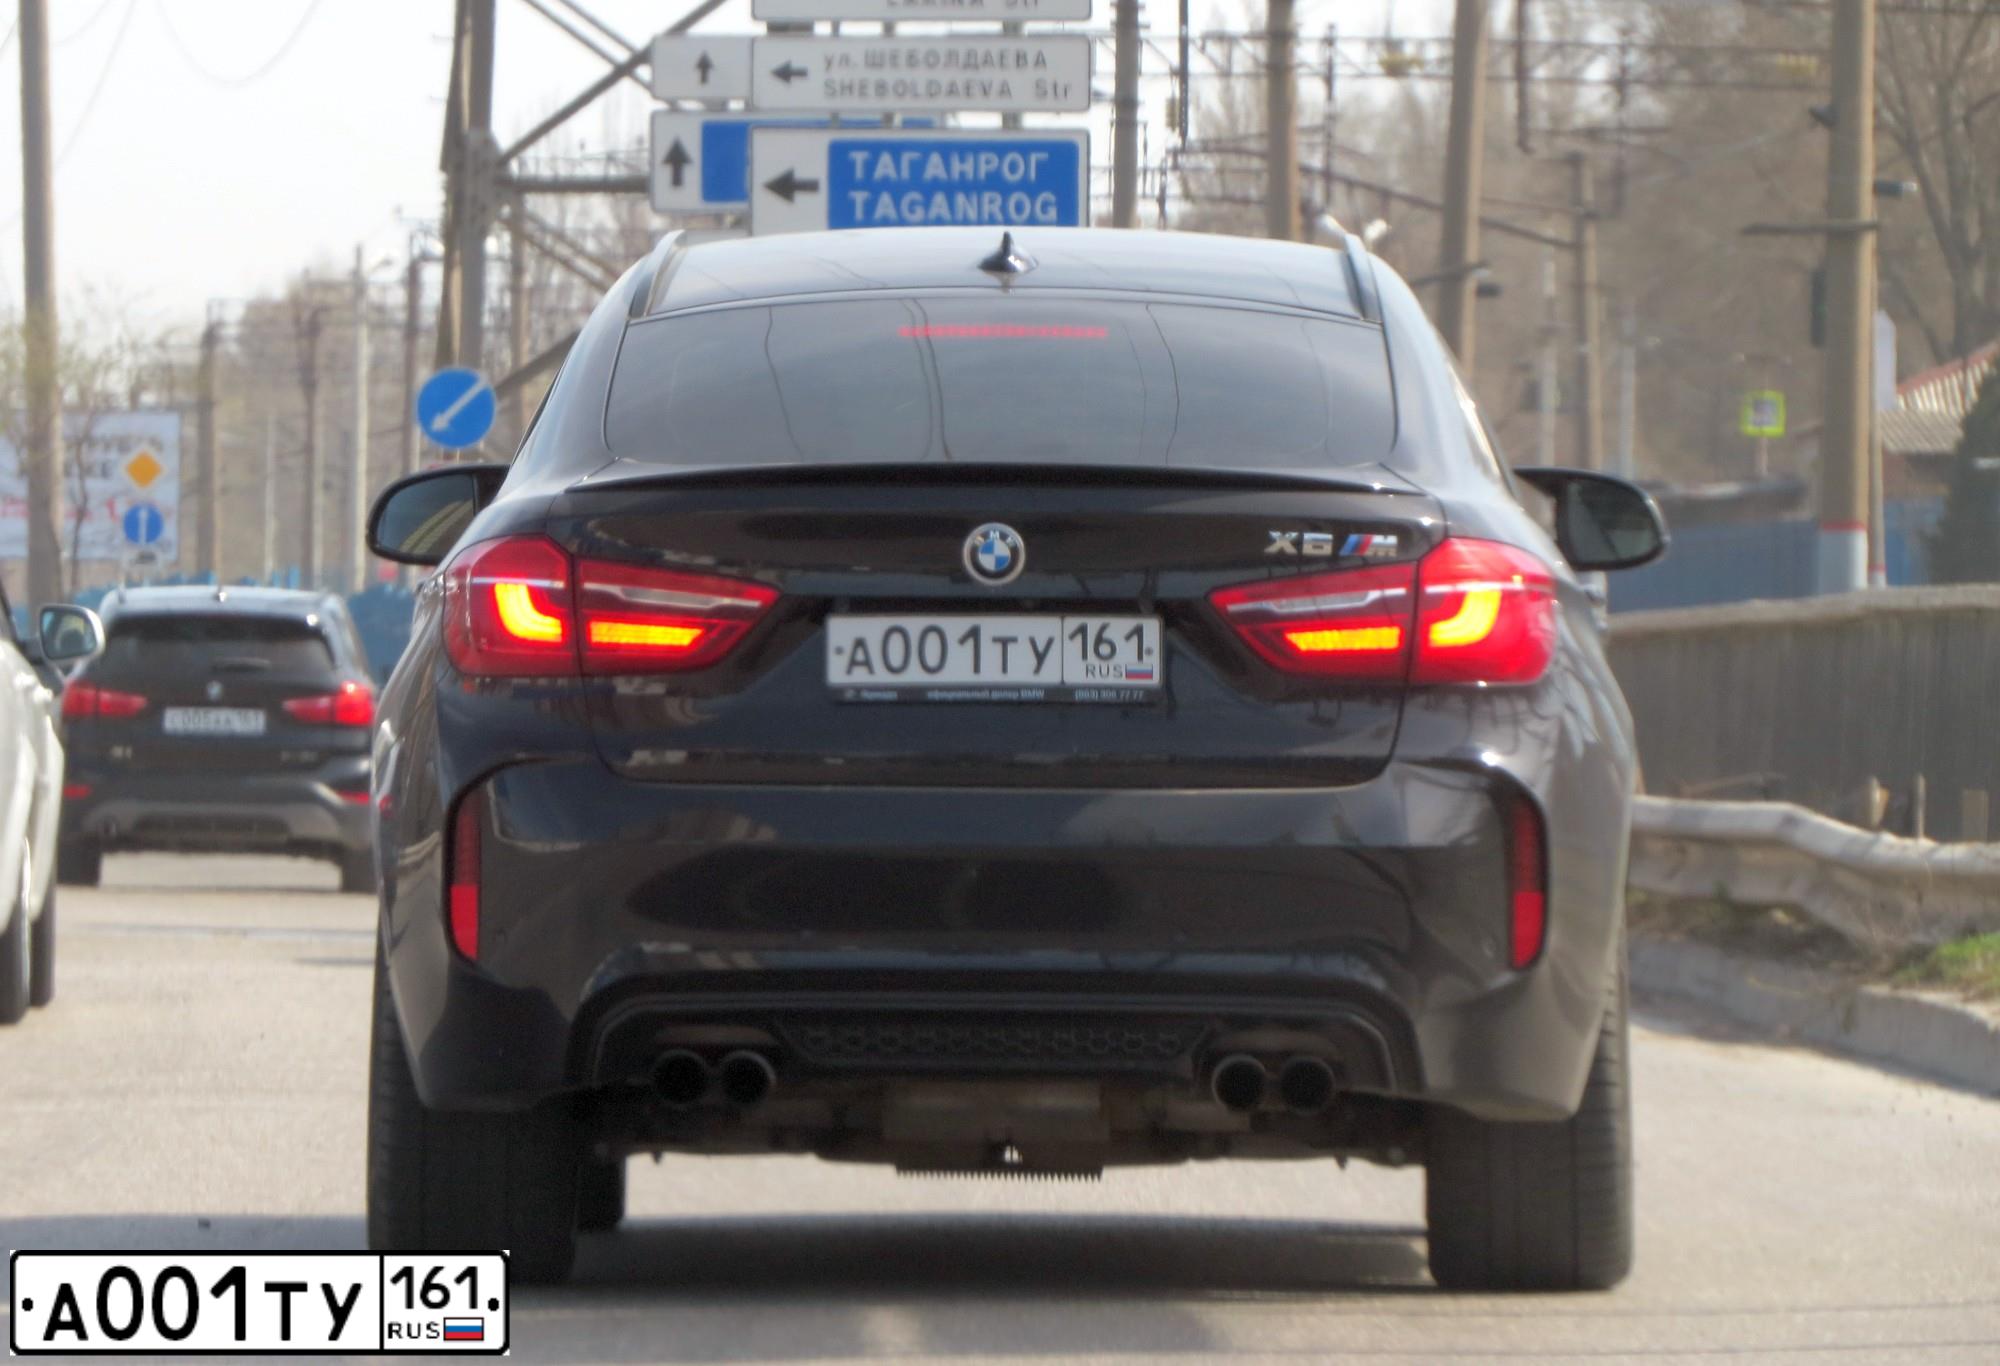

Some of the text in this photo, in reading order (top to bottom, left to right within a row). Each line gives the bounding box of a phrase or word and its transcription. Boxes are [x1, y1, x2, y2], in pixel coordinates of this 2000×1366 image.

[823, 49, 1048, 72] ул. ШЕБОЛДАЕВА
[823, 79, 1072, 99] SHEBOLDAEVA Str
[848, 151, 1049, 182] ТАГАНРОГ
[852, 192, 1058, 222] TAGANROG
[1264, 530, 1334, 556] X6
[1067, 623, 1143, 662] 161
[1084, 664, 1123, 679] RUS
